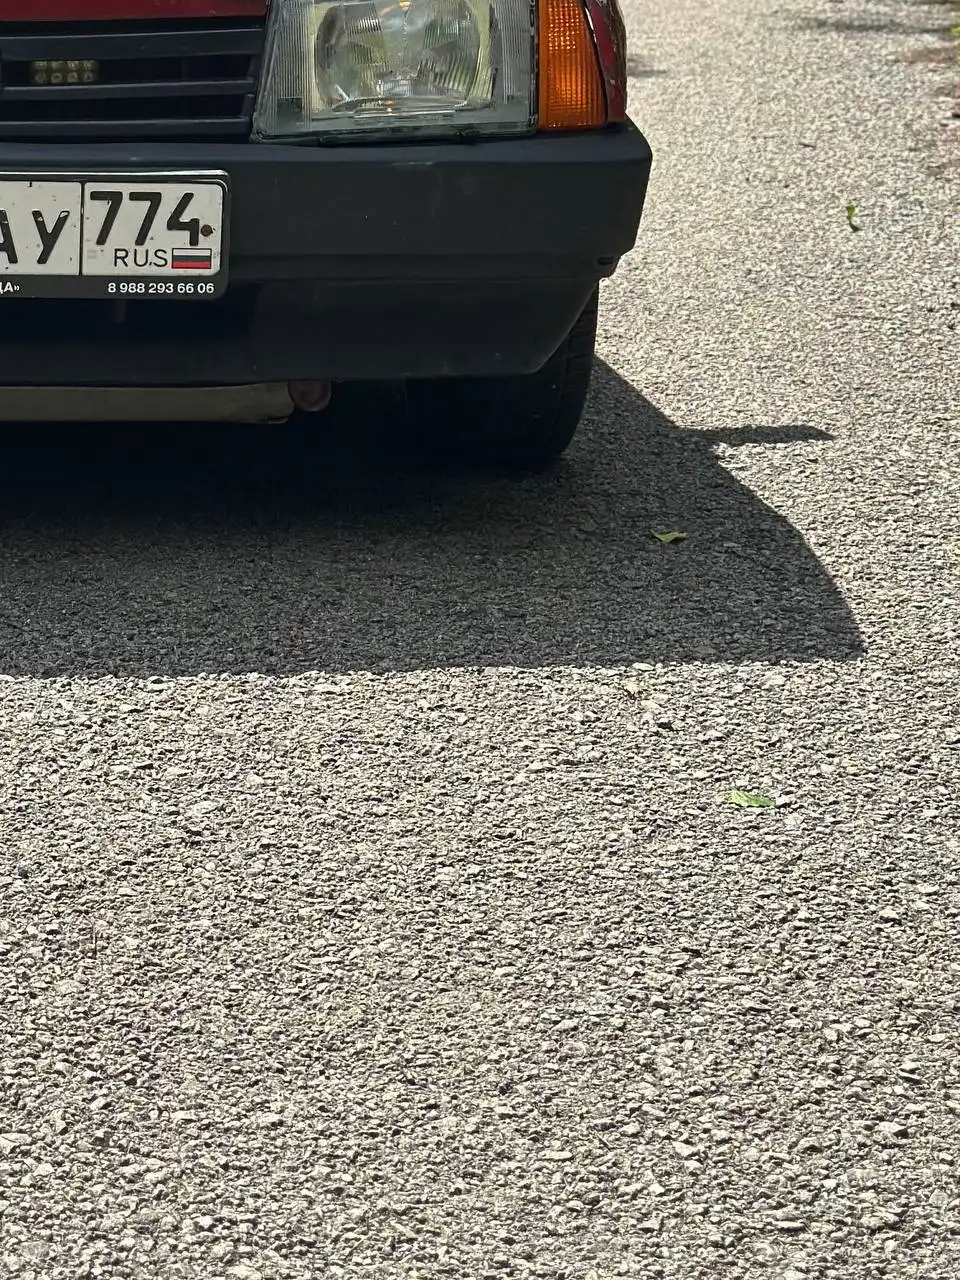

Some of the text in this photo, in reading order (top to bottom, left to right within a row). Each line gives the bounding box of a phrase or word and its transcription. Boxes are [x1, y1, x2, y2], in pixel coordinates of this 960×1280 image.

[90, 190, 200, 247] 774
[113, 248, 168, 267] RUS
[107, 282, 215, 294] 8 988 293 66 06
